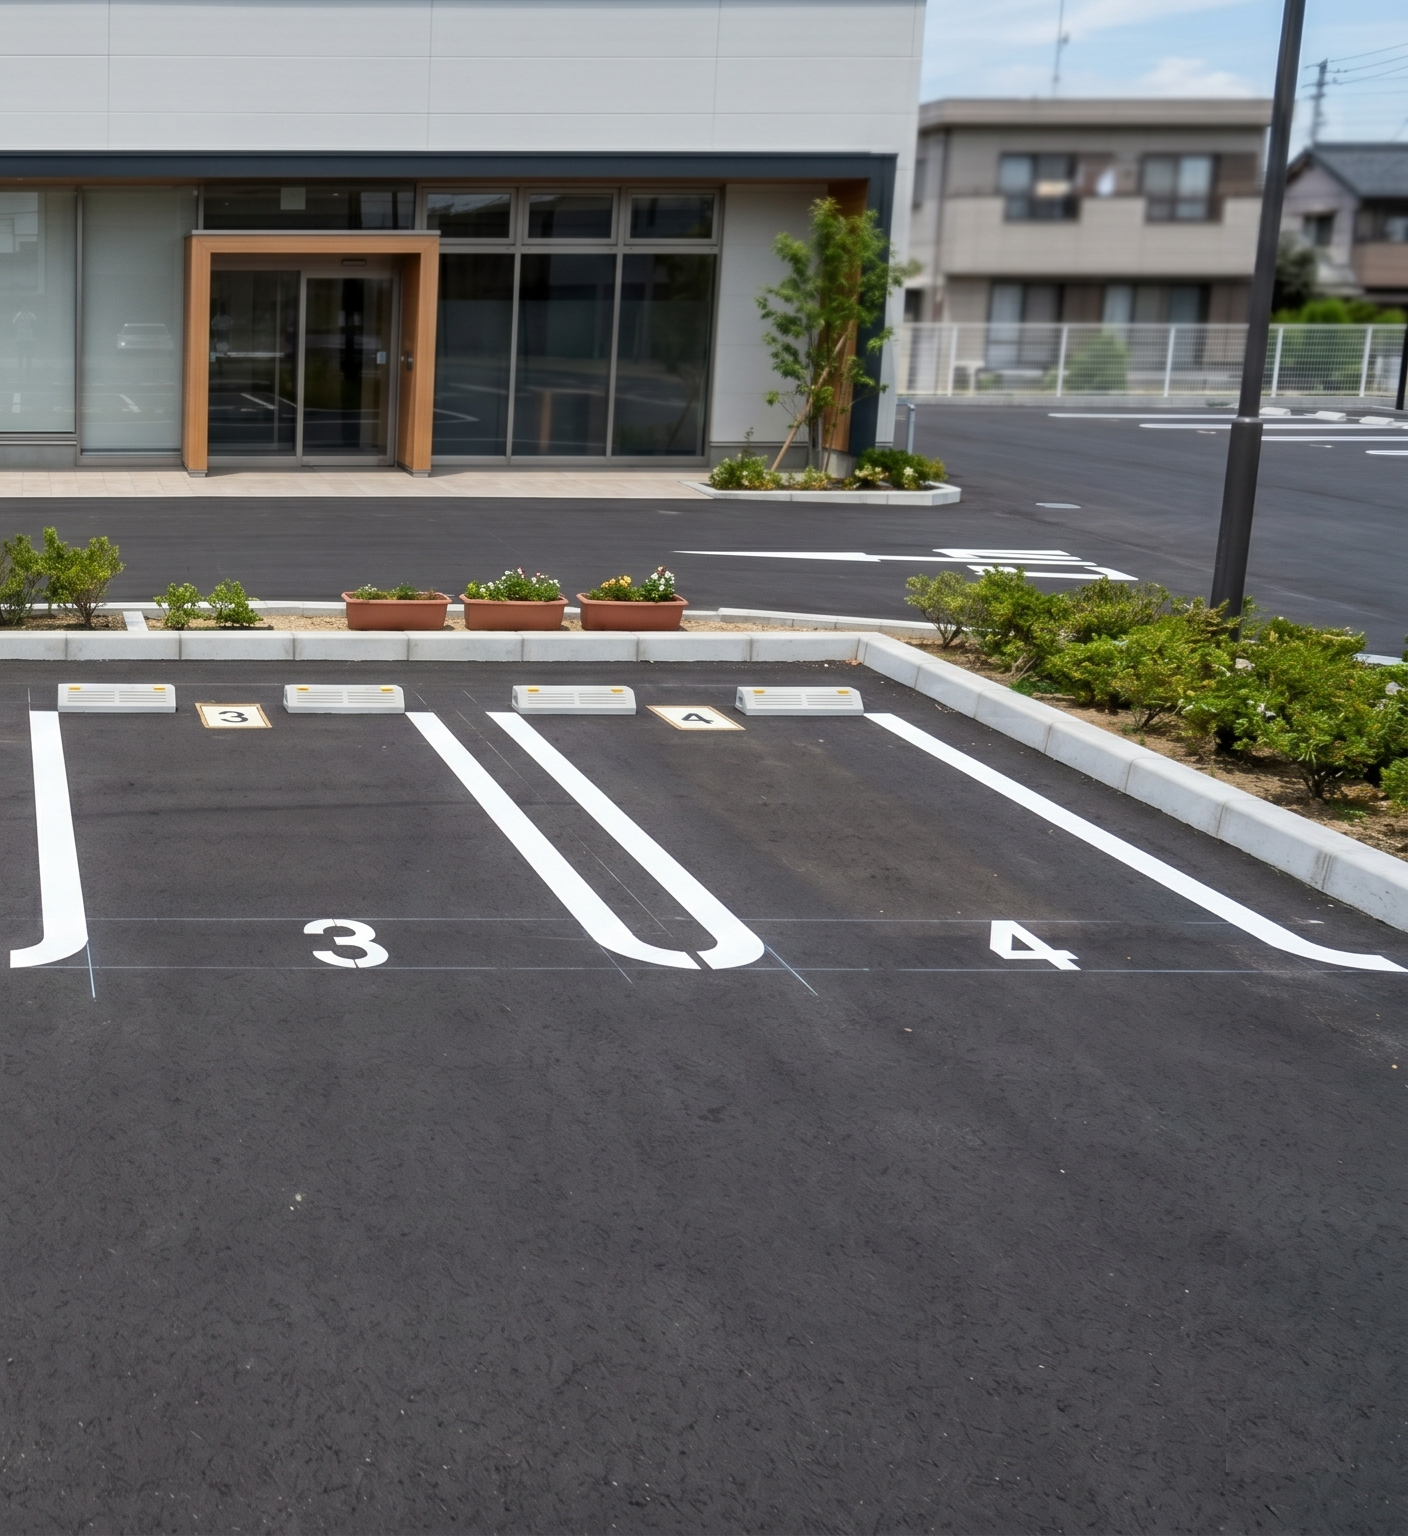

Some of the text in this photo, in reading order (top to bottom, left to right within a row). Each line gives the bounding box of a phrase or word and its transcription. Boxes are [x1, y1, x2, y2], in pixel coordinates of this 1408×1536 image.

[218, 710, 249, 723] 3
[681, 712, 714, 724] 4
[303, 918, 389, 968] 3
[989, 919, 1081, 971] 4
